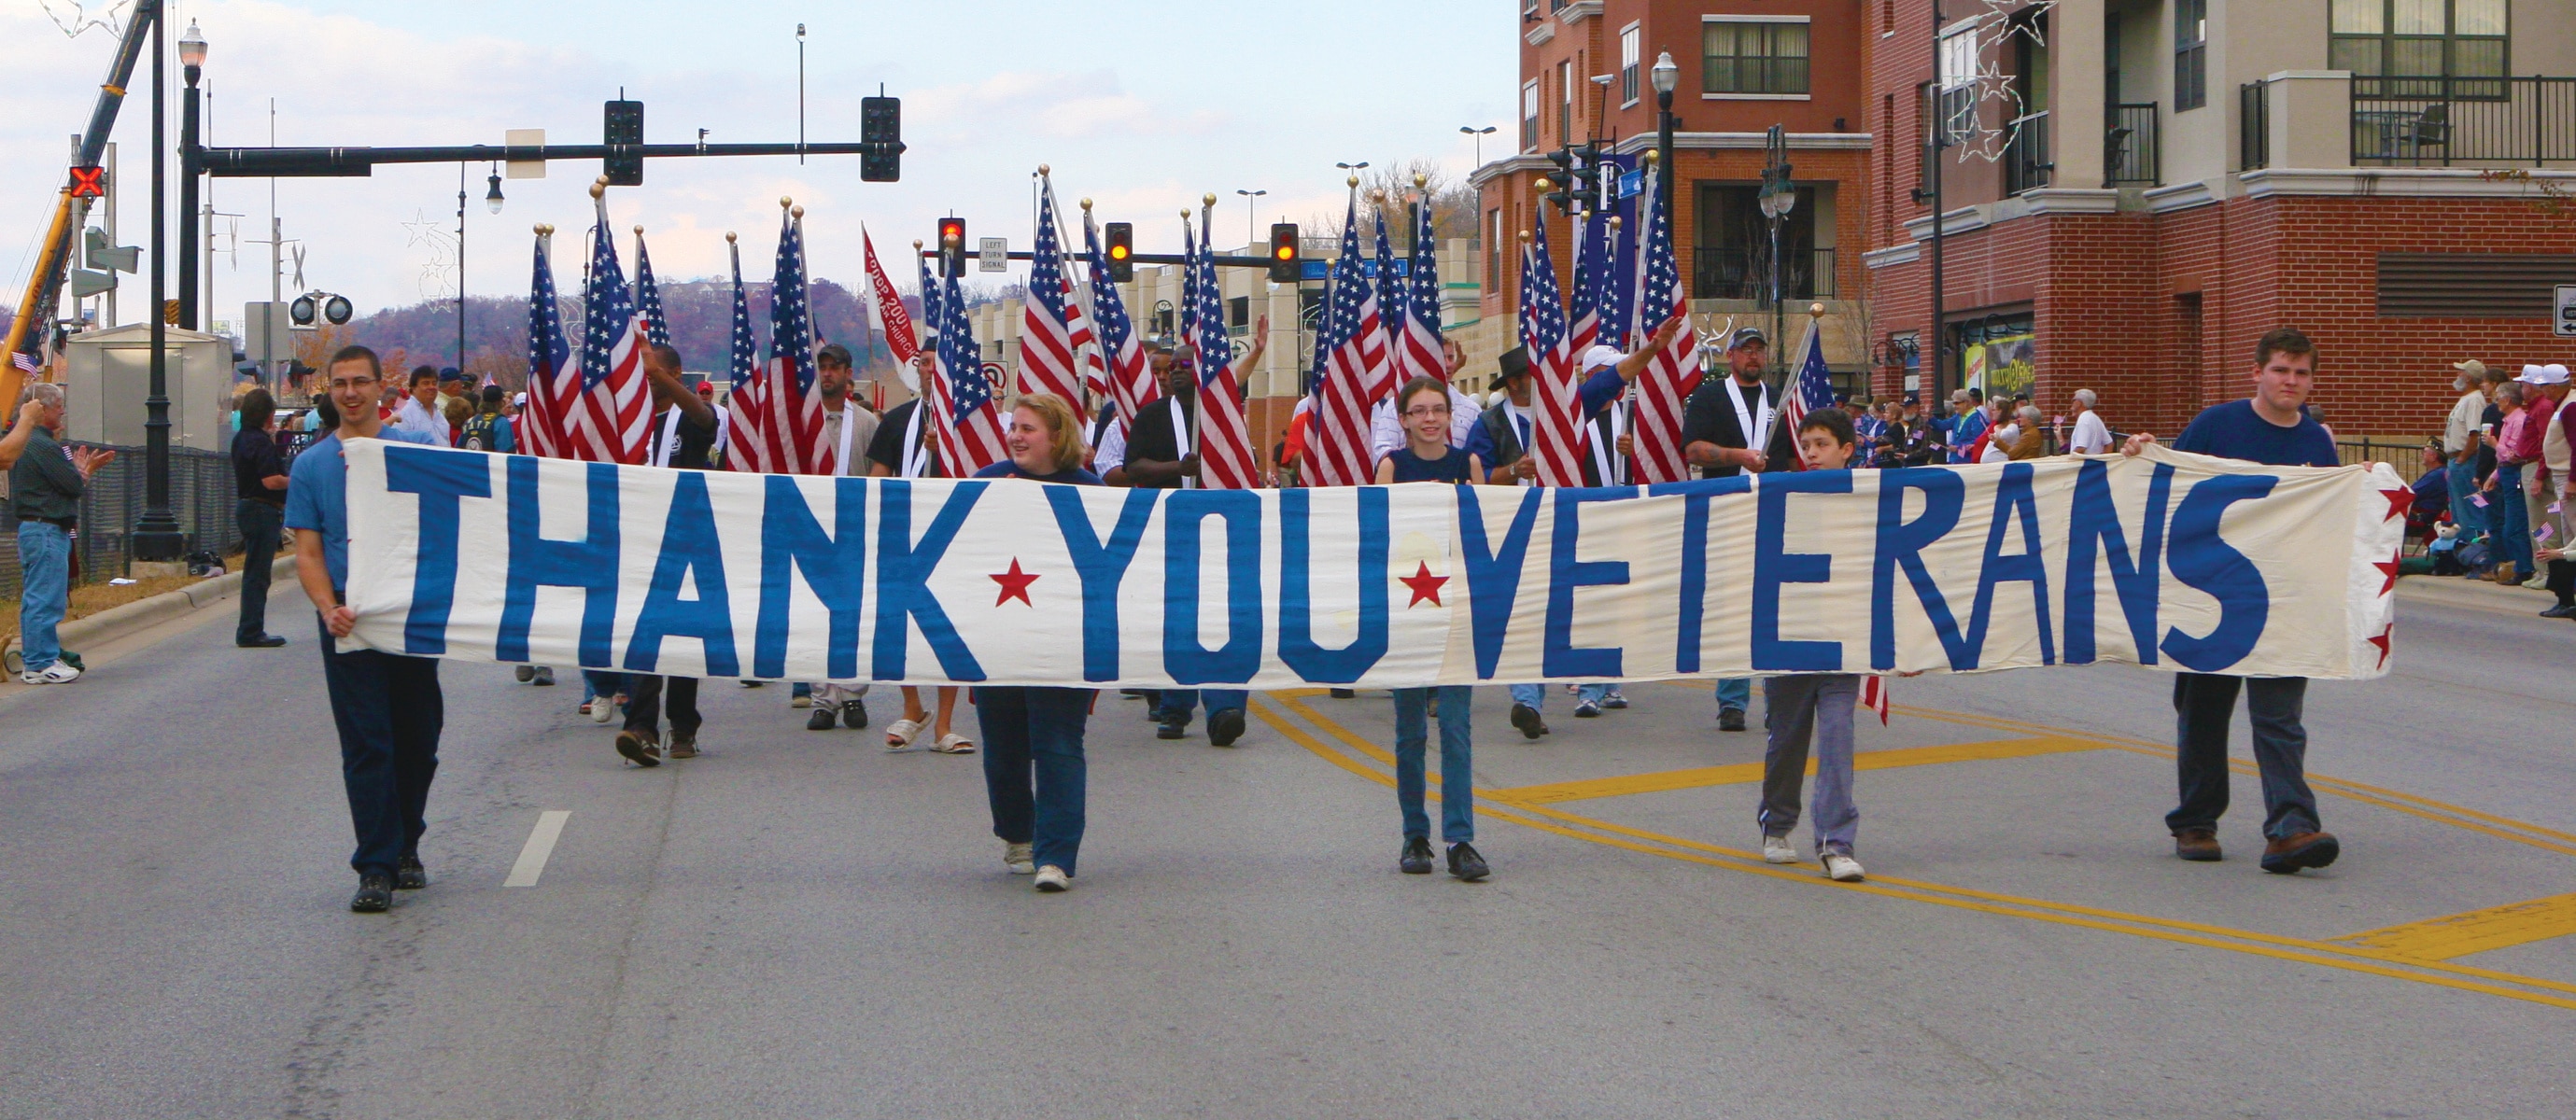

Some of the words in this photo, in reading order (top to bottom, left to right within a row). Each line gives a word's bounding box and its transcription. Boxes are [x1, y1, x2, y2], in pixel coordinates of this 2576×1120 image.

[981, 260, 1006, 269] SIGNAL
[885, 297, 909, 330] 2001
[888, 318, 915, 358] CHURCH
[384, 445, 991, 681] THANK
[1042, 485, 1389, 685] YOU
[1457, 459, 2280, 679] VETERANS
